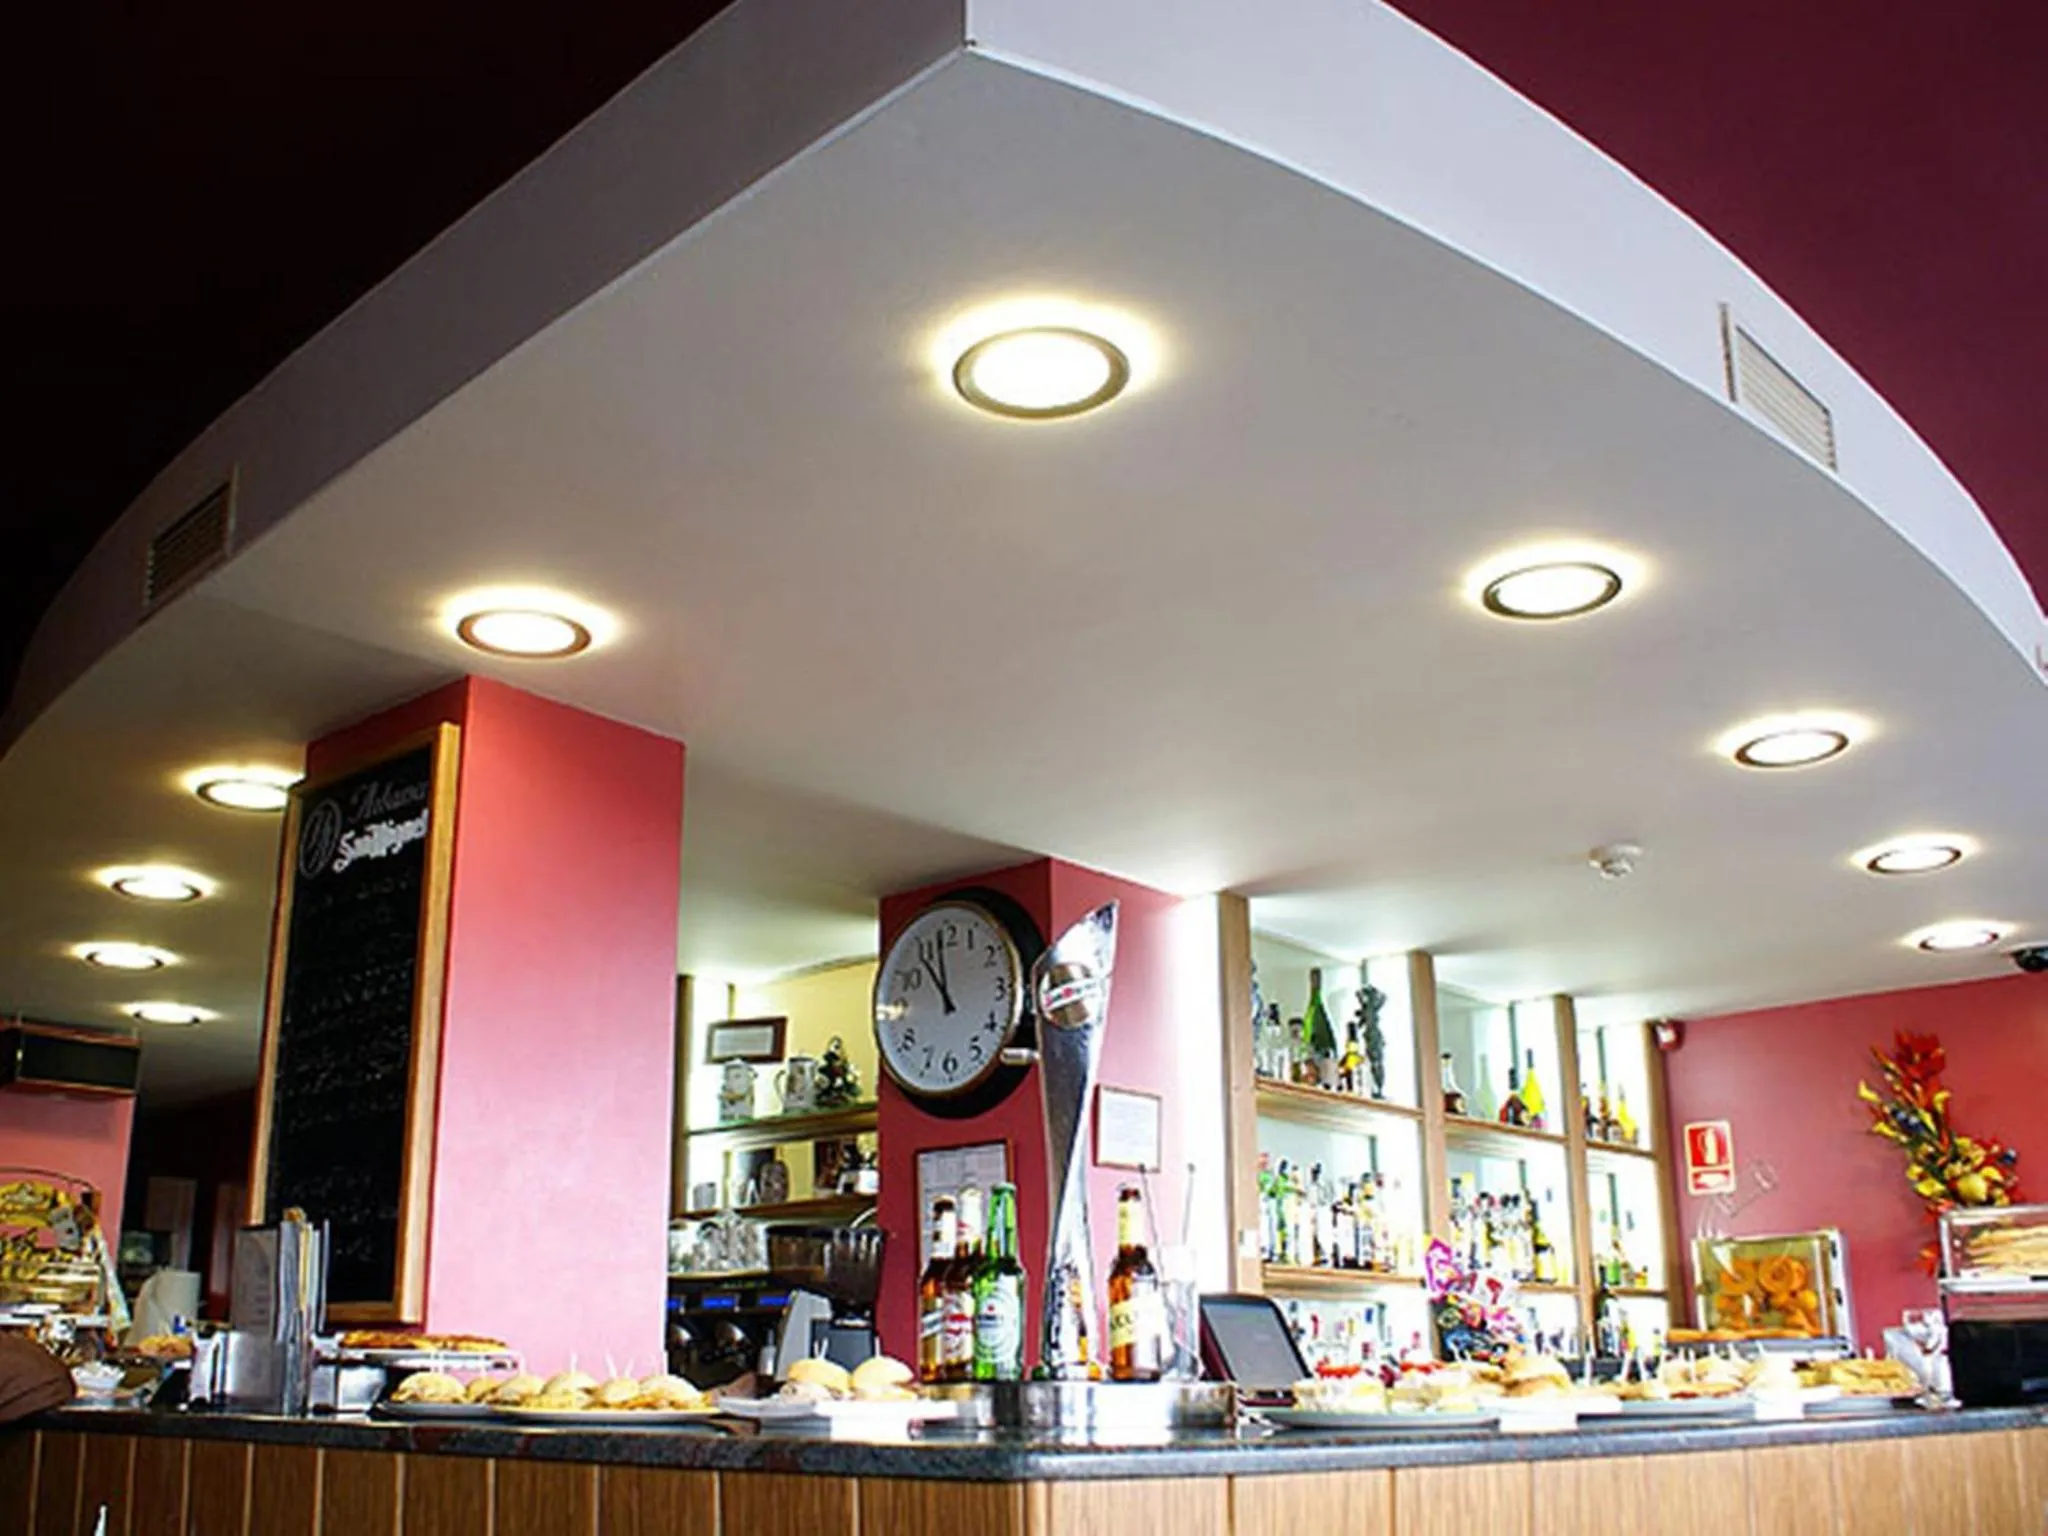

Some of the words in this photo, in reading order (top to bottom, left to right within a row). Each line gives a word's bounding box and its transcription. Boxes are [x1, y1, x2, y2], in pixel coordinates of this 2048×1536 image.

[966, 928, 974, 951] 1
[984, 945, 997, 967] 2
[995, 976, 1006, 1001] 3
[984, 1010, 997, 1033] 4
[902, 1027, 917, 1052] 8
[968, 1035, 983, 1062] 5
[922, 1047, 933, 1070] 7
[942, 1052, 958, 1075] 6
